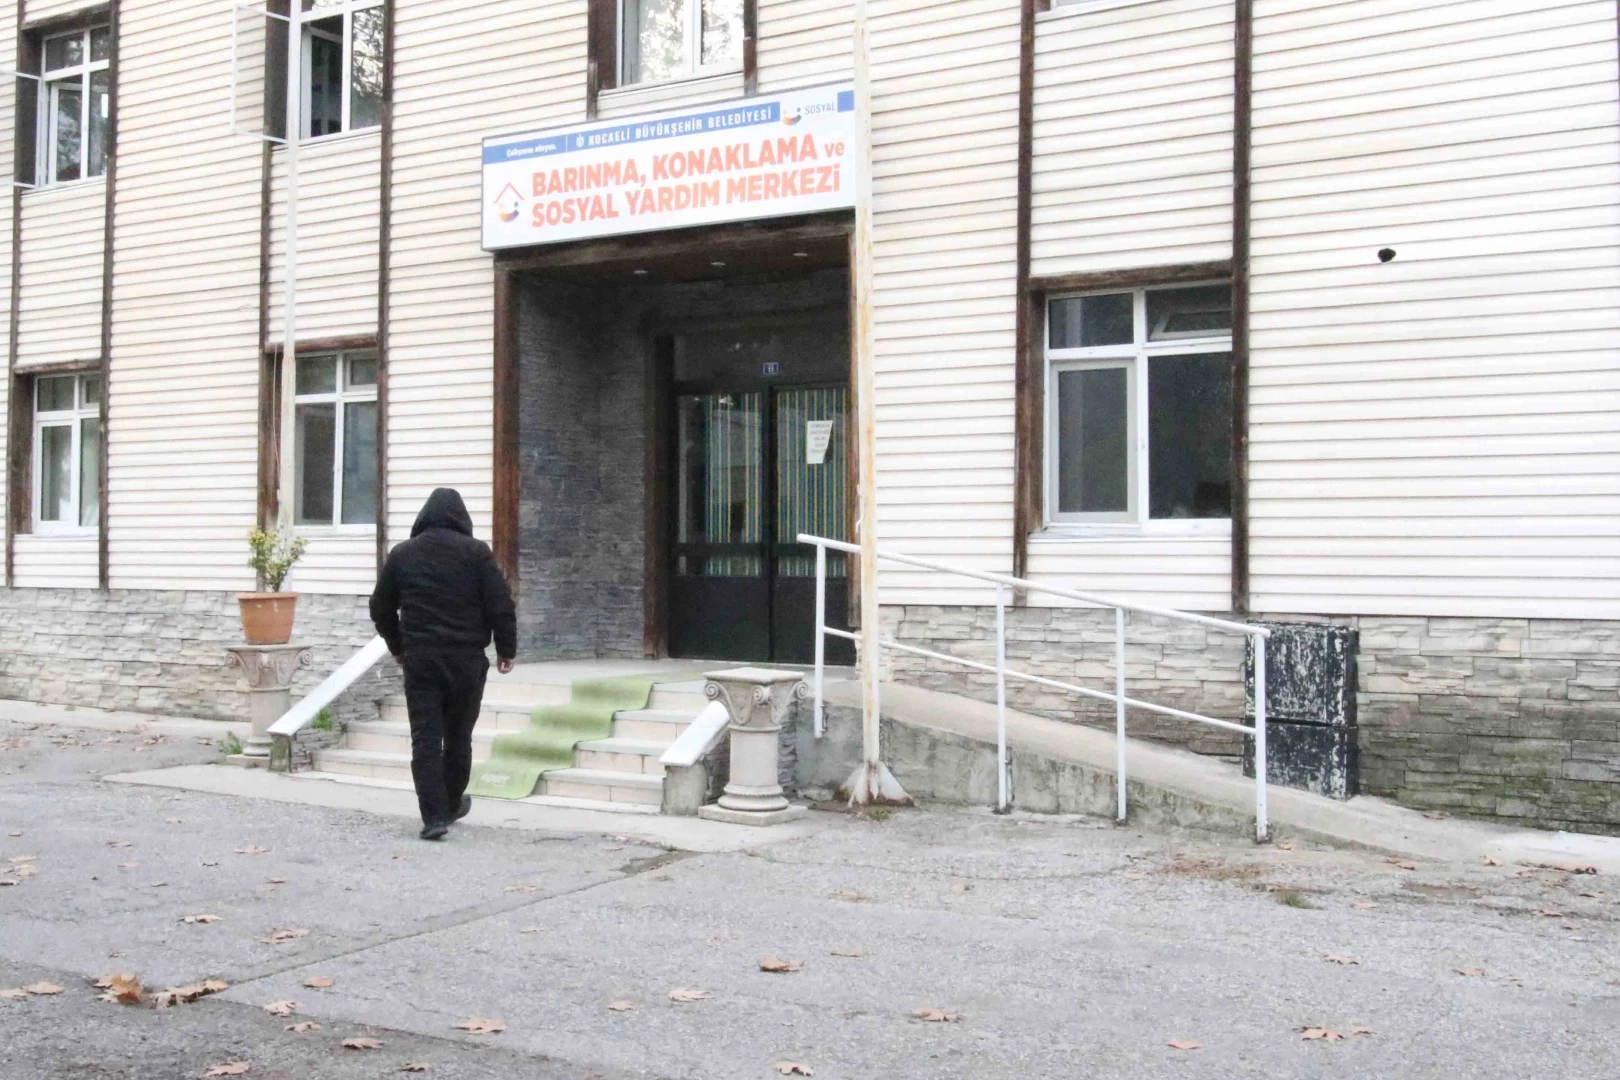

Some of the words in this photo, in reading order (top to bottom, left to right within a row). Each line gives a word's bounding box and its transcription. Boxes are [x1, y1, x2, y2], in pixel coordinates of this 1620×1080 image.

[588, 131, 631, 146] KOCAELİ
[635, 117, 703, 139] BÜYÜKŞEHİR
[708, 105, 772, 129] BELEDİYESİ
[804, 102, 836, 115] SOSYAL
[532, 158, 647, 197] BARINMA,
[652, 133, 818, 181] KONAKLAMA
[824, 141, 845, 158] ve
[532, 193, 619, 228] SOSYAL
[625, 179, 720, 216] YARDIM
